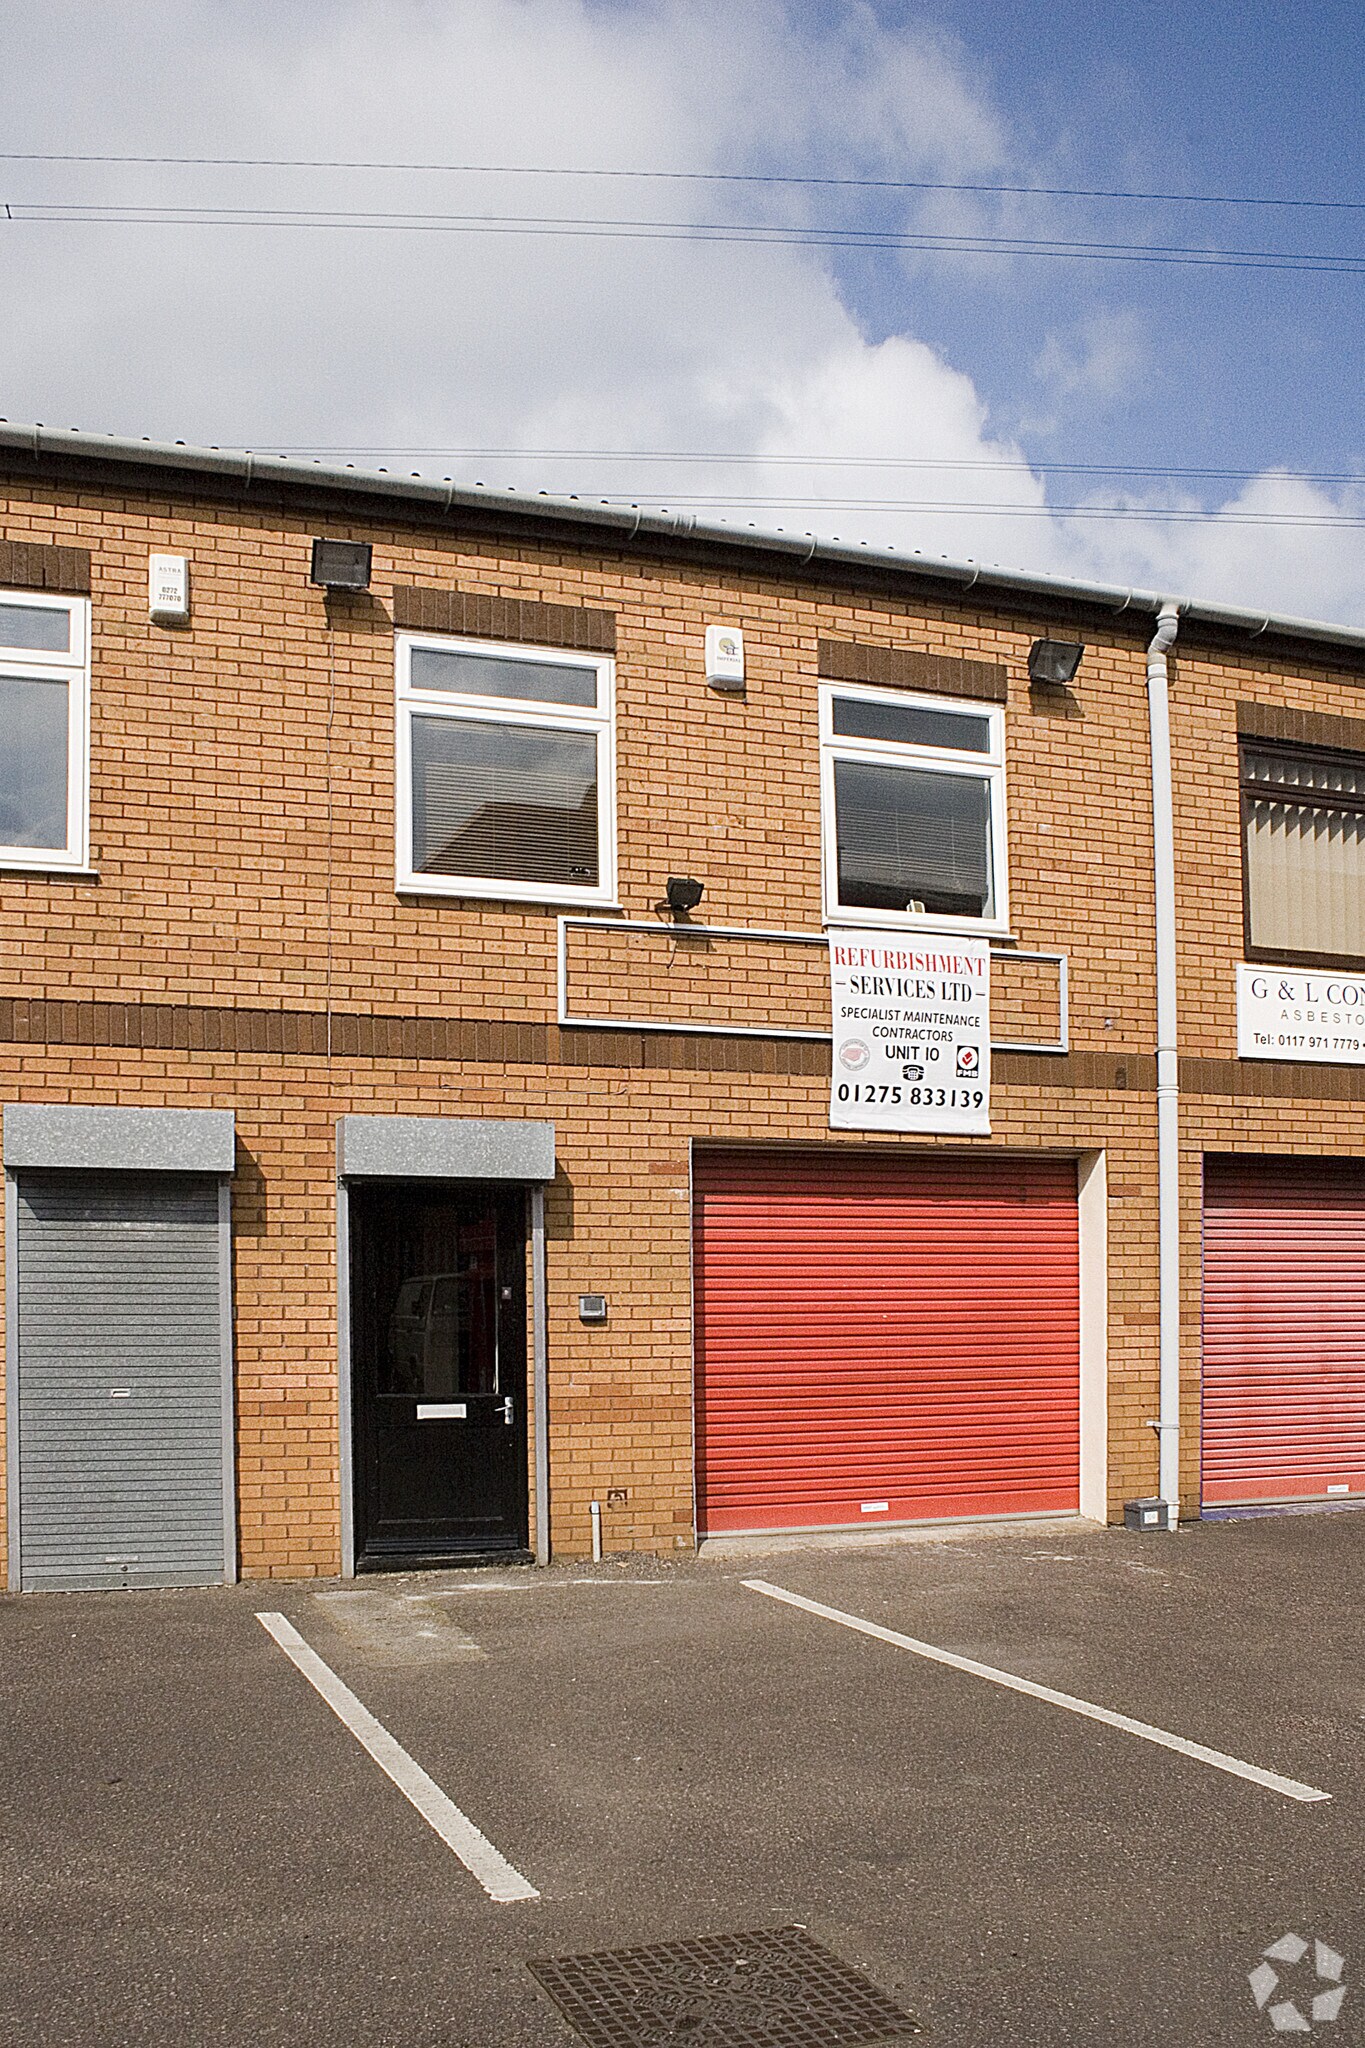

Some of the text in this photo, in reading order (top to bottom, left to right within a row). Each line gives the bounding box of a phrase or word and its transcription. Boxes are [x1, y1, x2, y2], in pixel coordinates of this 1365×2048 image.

[834, 946, 986, 977] REFURBISHMENT
[850, 974, 972, 1002] SERVICES LTD
[1252, 978, 1268, 998] G
[1278, 980, 1295, 1000] &
[1306, 983, 1318, 1002] L
[841, 1006, 981, 1028] SPECIALIST MAINTENANCE
[872, 1026, 953, 1042] CONTRACTORS
[1253, 1033, 1359, 1050] Tel: 0117 971 7779
[885, 1045, 920, 1060] UNIT
[925, 1047, 940, 1061] 10
[957, 1069, 978, 1078] FMB
[838, 1084, 983, 1109] 01275 833139
